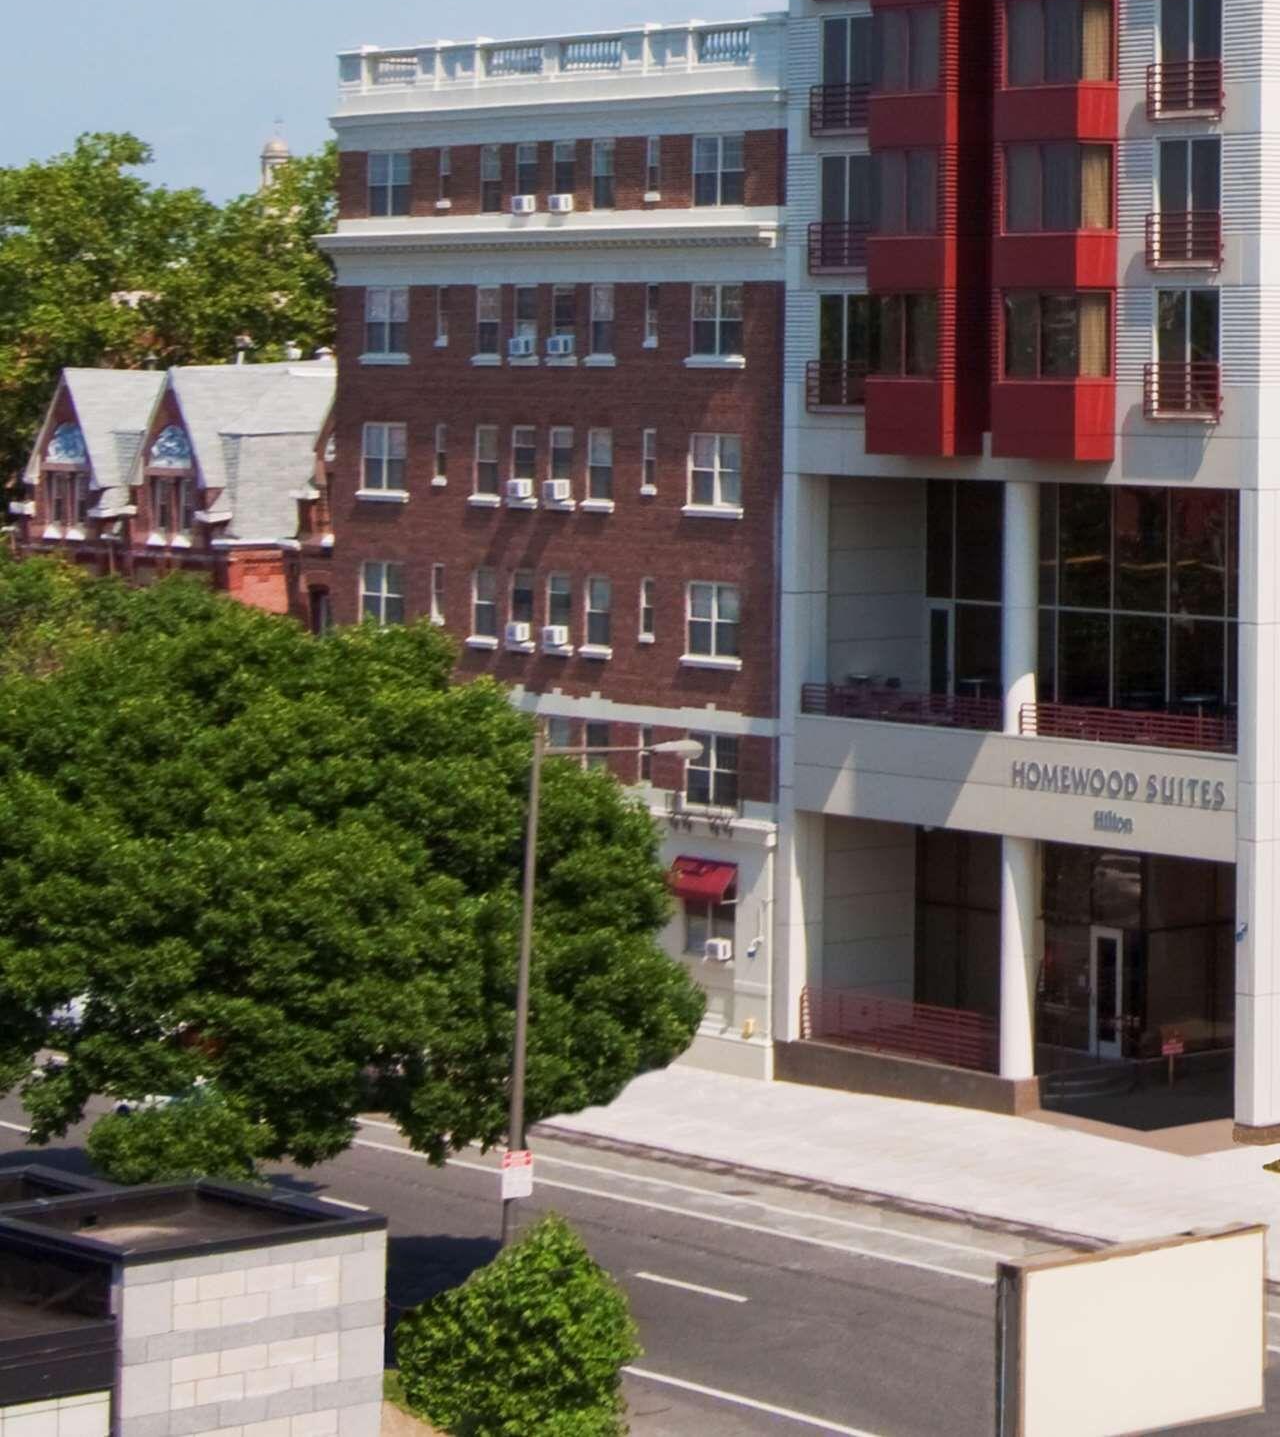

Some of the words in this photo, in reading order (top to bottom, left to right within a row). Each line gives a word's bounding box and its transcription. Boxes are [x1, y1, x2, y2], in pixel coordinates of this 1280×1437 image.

[1011, 760, 1139, 801] HOMEWOOD
[1146, 774, 1226, 811] SUITES
[1094, 810, 1133, 834] Hilton
